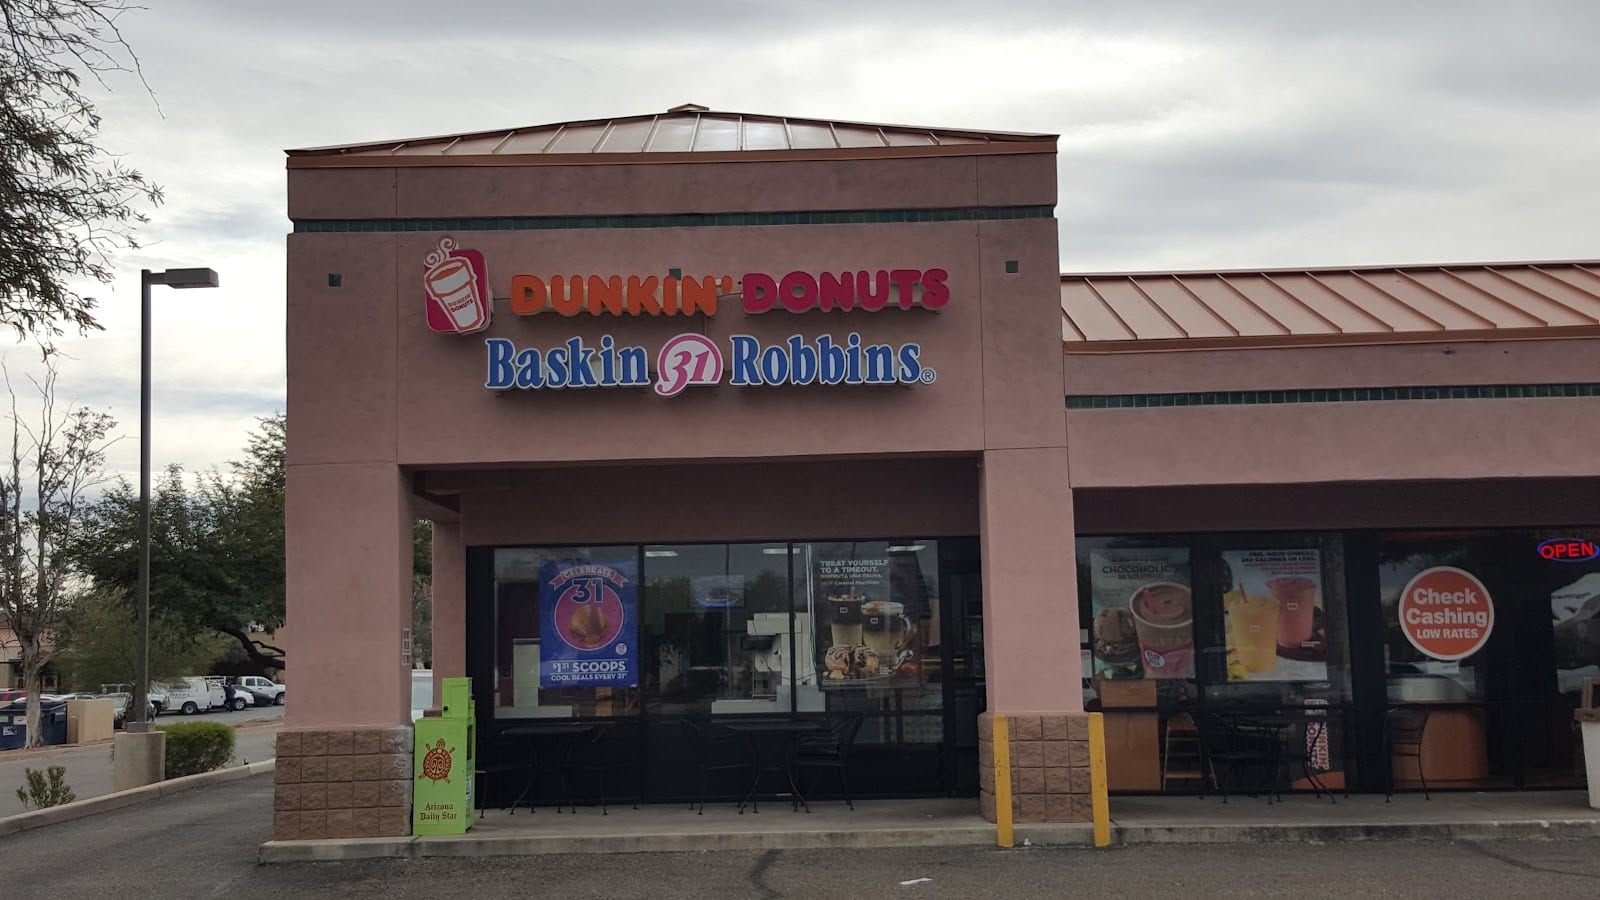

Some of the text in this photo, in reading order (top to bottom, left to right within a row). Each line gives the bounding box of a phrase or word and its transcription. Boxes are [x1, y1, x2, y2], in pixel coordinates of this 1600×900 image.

[510, 268, 951, 316] DUNKIN' DONUTS
[451, 298, 474, 313] DONUTS
[485, 335, 650, 389] Baskin
[656, 341, 715, 396] 31
[1540, 542, 1594, 560] OPEN
[563, 567, 612, 578] CELEBRATE
[571, 578, 604, 604] 31
[1413, 587, 1478, 604] Check
[1406, 608, 1488, 627] Cashing
[1416, 628, 1479, 639] LOW RATES
[572, 661, 626, 673] SCOOPS
[424, 803, 454, 811] Arizona
[419, 811, 458, 822] Daily Star
